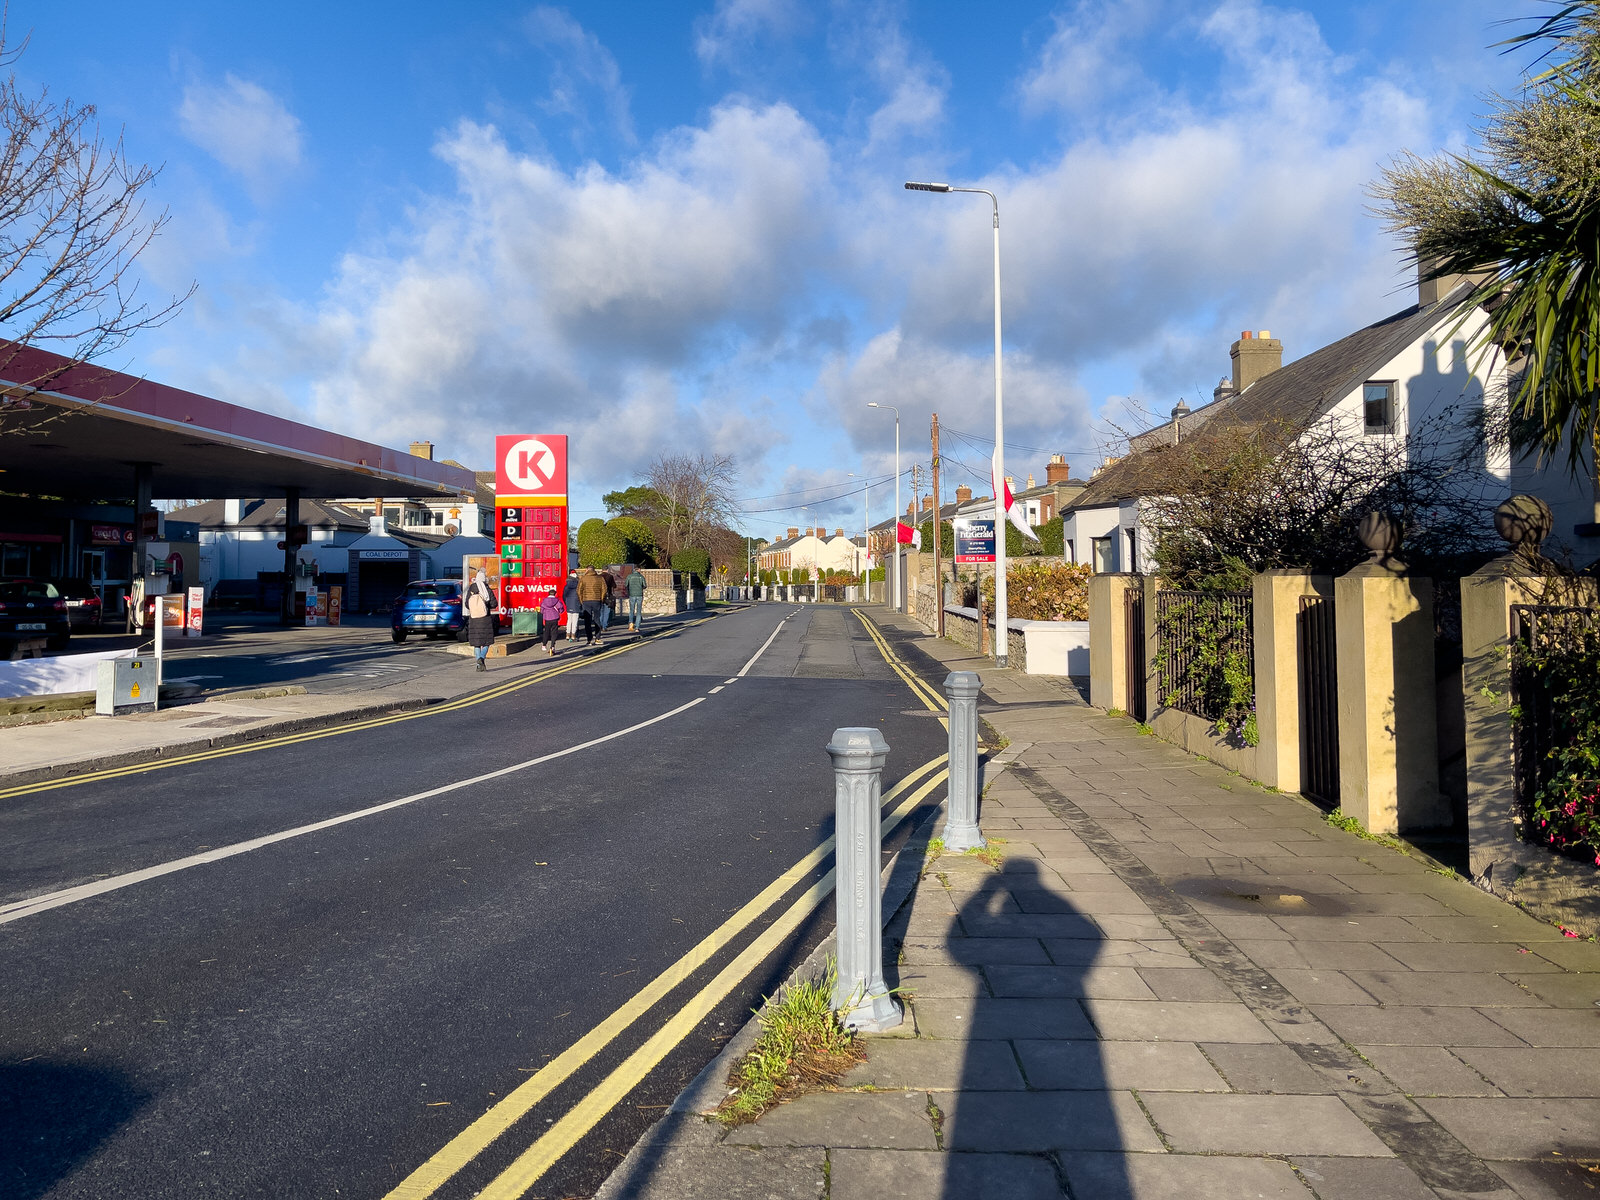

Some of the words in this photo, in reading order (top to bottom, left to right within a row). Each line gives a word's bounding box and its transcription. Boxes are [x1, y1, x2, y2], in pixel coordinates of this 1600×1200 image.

[518, 450, 550, 486] K
[507, 508, 516, 517] D
[507, 526, 516, 535] D
[508, 545, 515, 554] U
[508, 562, 515, 571] U
[505, 584, 525, 592] CAR
[527, 584, 557, 592] WASH
